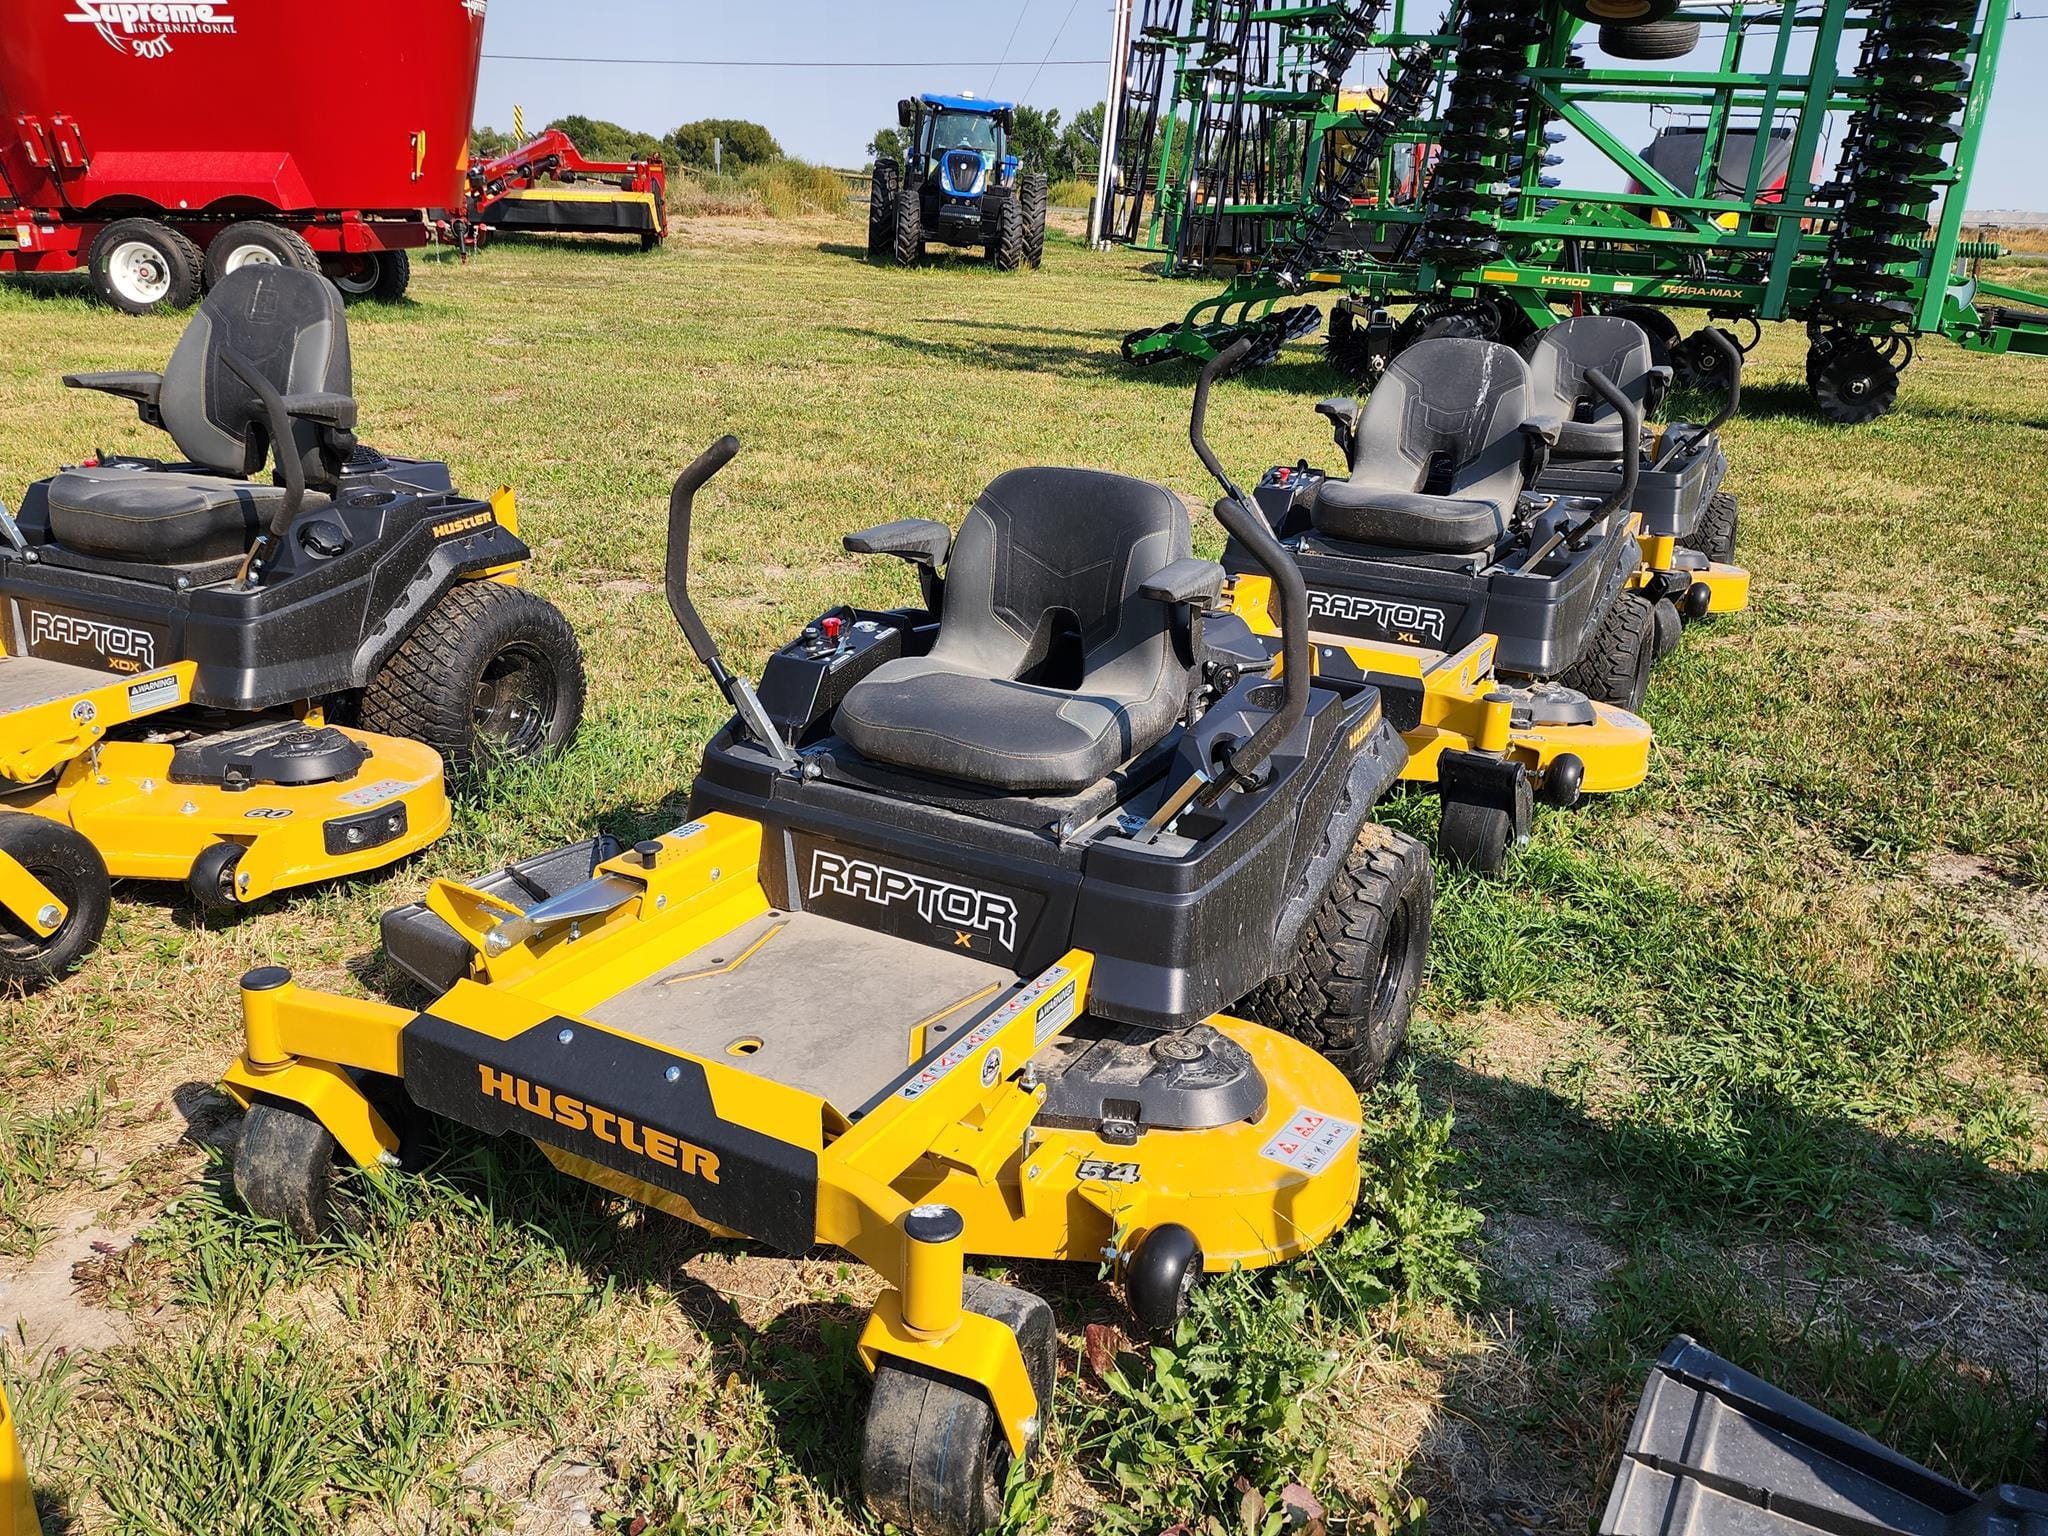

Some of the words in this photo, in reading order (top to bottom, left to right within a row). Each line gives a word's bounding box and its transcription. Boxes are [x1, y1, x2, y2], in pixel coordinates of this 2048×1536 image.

[64, 0, 235, 33] Supreme
[133, 23, 237, 34] INTERNATIONAL
[132, 34, 174, 59] 900T
[1541, 275, 1590, 288] HT1100
[1661, 284, 1743, 299] TERRA-MAX
[432, 511, 492, 538] HUSTLER
[1306, 590, 1446, 642] RAPTOR
[31, 610, 155, 670] RAPTOR
[1397, 632, 1421, 644] XL
[108, 657, 141, 673] XDX
[137, 677, 176, 693] WARNING!
[244, 808, 293, 819] 60
[808, 849, 1018, 953] RAPTOR
[953, 930, 972, 948] X
[479, 1064, 720, 1185] HUSTLER
[1077, 1160, 1140, 1183] 54
